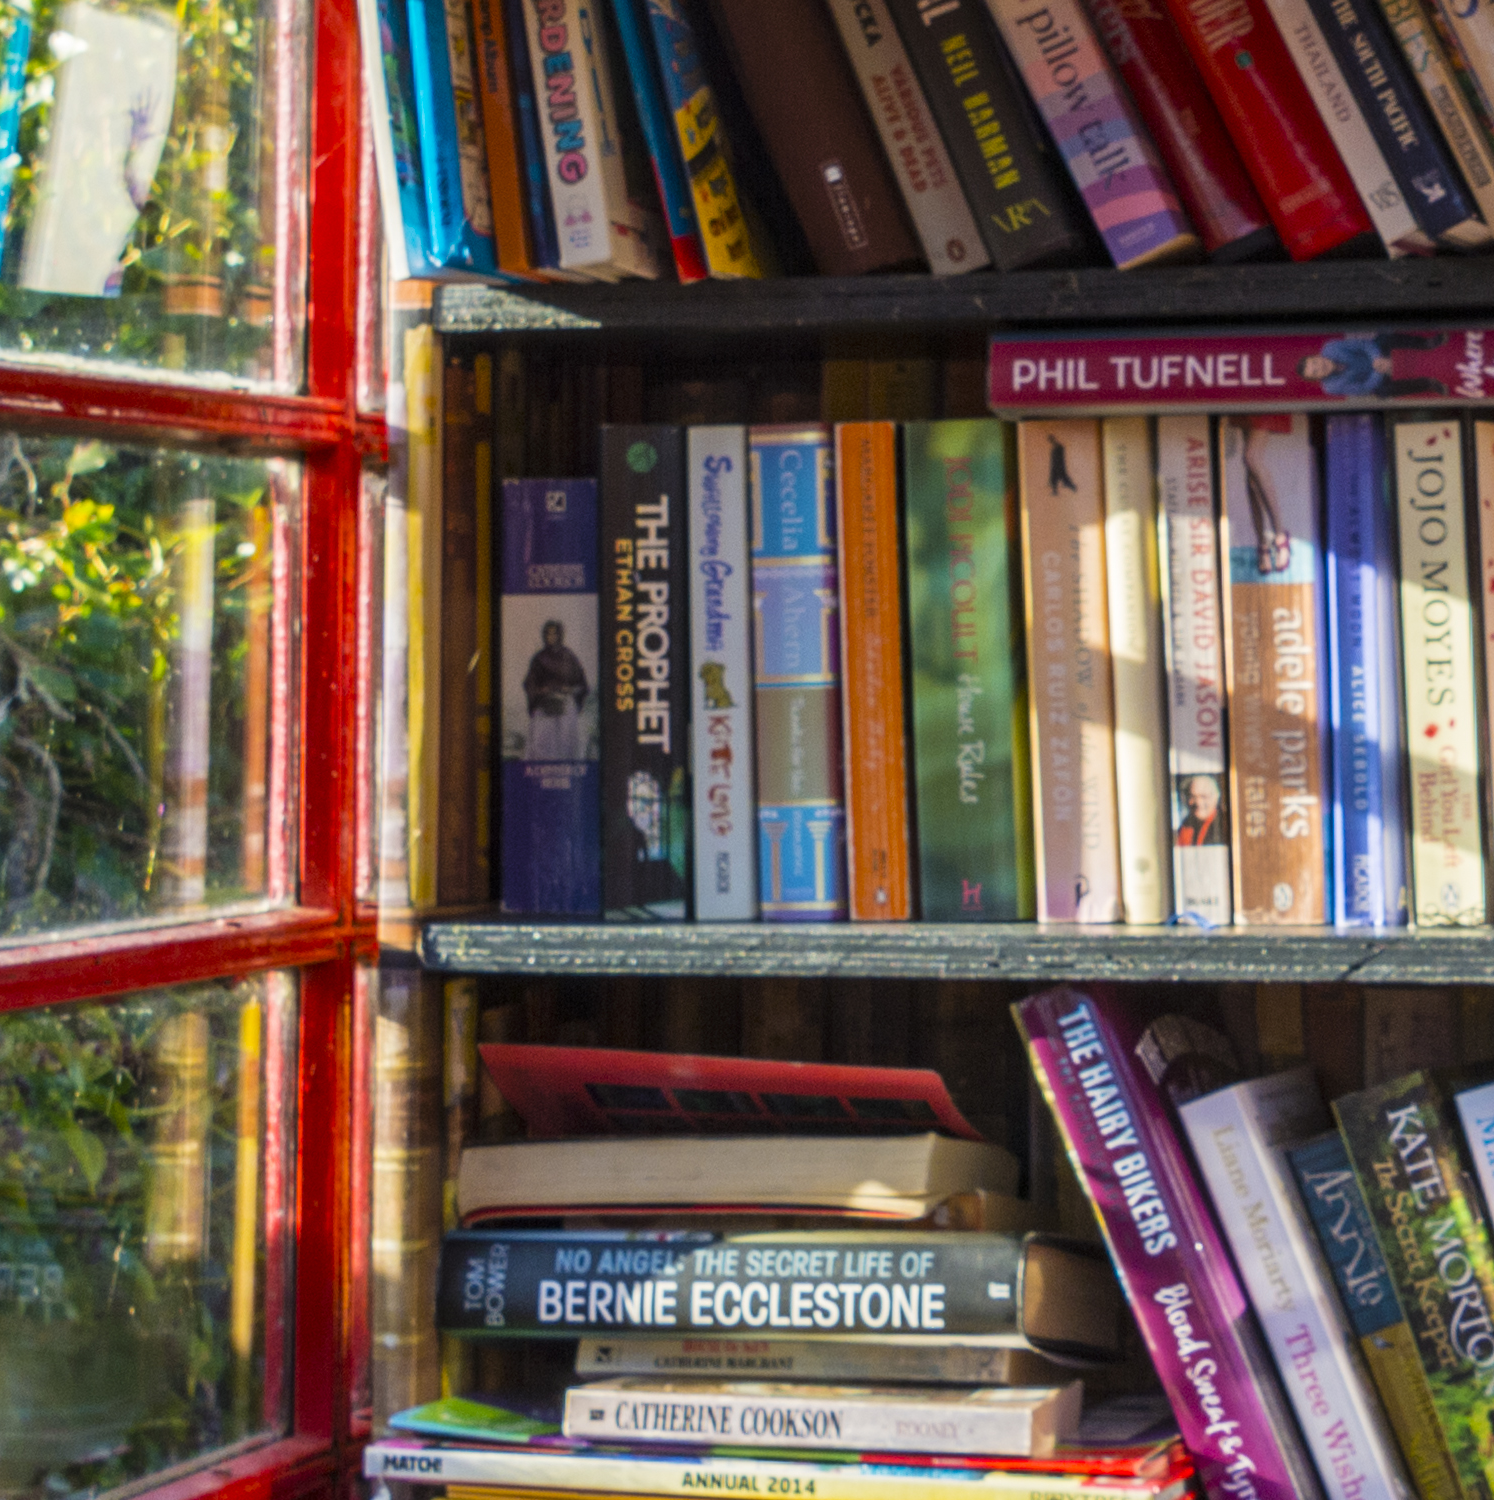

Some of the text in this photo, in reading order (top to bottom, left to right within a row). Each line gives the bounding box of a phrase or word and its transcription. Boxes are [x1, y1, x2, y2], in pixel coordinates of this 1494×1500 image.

[1015, 0, 1138, 190] pillow talk
[1289, 21, 1356, 125] THAILAND
[1347, 31, 1390, 90] SOUTH
[1375, 87, 1422, 153] PACIFIC
[1012, 353, 1286, 391] PHIL TUFNELL
[1455, 331, 1484, 398] Where
[779, 450, 804, 550] Cecelia
[943, 456, 978, 664] JODI PICOULT
[1185, 437, 1219, 748] ARISE SIR DAVID JASON
[1408, 448, 1456, 707] JOJO MOYES
[613, 538, 635, 711] ETHAN CROSS
[634, 494, 672, 754] THE PROPHET
[782, 590, 805, 669] Ahern
[1269, 605, 1319, 839] adele parks
[1418, 770, 1439, 845] Behind
[1437, 746, 1460, 869] Girl You Left
[1055, 1001, 1179, 1257] THE HAIRY BIKERS
[1379, 1101, 1450, 1212] KATE
[555, 1249, 935, 1278] NO ANGEL: THE SECRET LIFE OF
[1210, 1122, 1300, 1316] Liane Moriarty
[1370, 1155, 1465, 1376] The Secret Keeper
[465, 1259, 486, 1312] TOM
[485, 1244, 508, 1327] BOWER
[538, 1280, 946, 1329] BERNIE ECCLESTONE
[615, 1401, 843, 1439] CATHERINE COOKSON
[1280, 1322, 1339, 1419] Three
[682, 1471, 816, 1497] ANNUAL 2014
